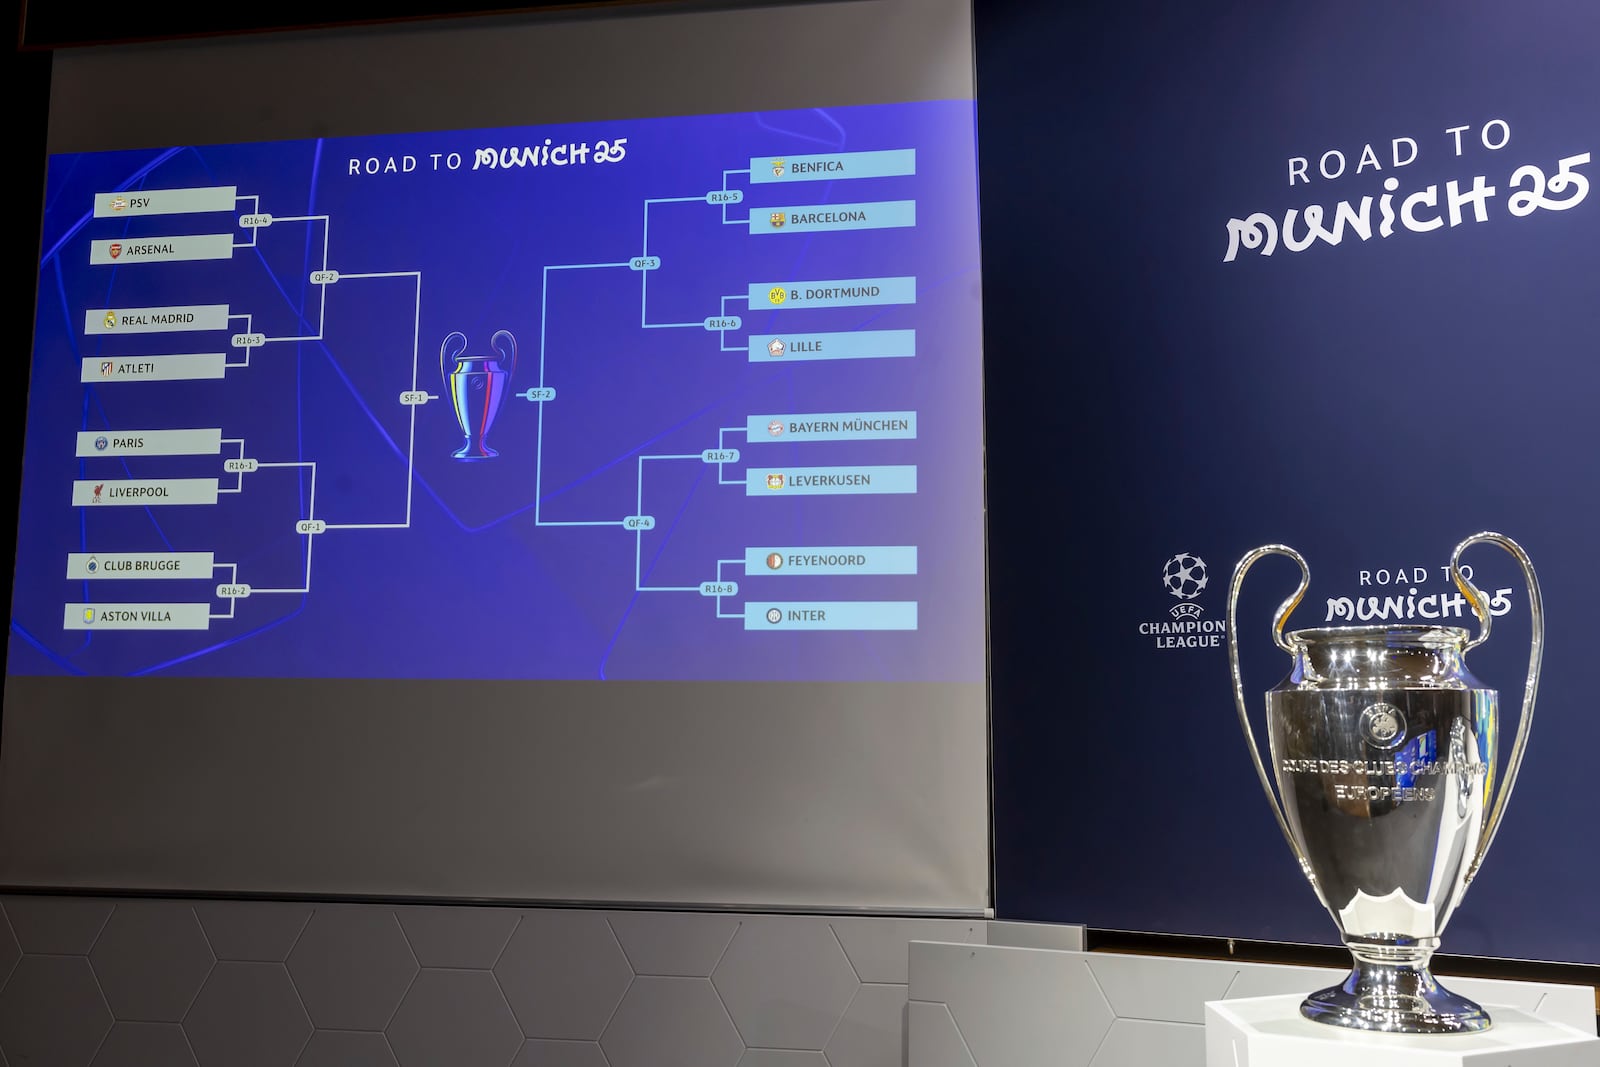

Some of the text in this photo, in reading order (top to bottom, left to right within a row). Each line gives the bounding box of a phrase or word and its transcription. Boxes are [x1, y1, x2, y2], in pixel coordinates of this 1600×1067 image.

[349, 156, 416, 175] ROAD
[430, 153, 461, 170] TO
[594, 138, 627, 163] 25
[1288, 119, 1511, 185] ROAD TO
[792, 161, 843, 173] BENFICA
[1508, 152, 1591, 216] 25
[130, 198, 150, 208] PSV
[711, 193, 738, 202] R16-5
[244, 216, 267, 225] R16-4
[791, 211, 866, 224] BARCELONA
[127, 244, 174, 255] ARSENAL
[634, 259, 655, 268] QF-3
[315, 273, 333, 282] QF-2
[791, 286, 880, 299] B. DORTMUND
[122, 313, 194, 325] REAL MADRID
[709, 319, 736, 328] R16-6
[236, 336, 260, 344] R16-3
[790, 341, 822, 352] LILLE
[118, 363, 154, 374] ATLETI
[404, 394, 422, 402] SF-1
[532, 390, 550, 399] SF-2
[789, 417, 908, 433] BAYERN MÜNCHEN
[113, 438, 144, 449] PARIS
[707, 452, 734, 461] R16-7
[229, 462, 253, 470] R16-1
[789, 474, 870, 487] LEVERKUSEN
[109, 486, 168, 498] LIVERPOOL
[301, 523, 320, 532] QF-1
[628, 519, 650, 528] QF-4
[104, 560, 180, 571] CLUB BRUGGE
[788, 555, 865, 566] FEYENOORD
[1360, 565, 1473, 585] ROAD TO
[221, 587, 245, 595] R16-2
[705, 584, 732, 593] R16-8
[101, 611, 171, 622] ASTON VILLA
[788, 610, 825, 621] INTER
[1171, 606, 1201, 617] UEFA
[1139, 620, 1226, 634] CHAMPION
